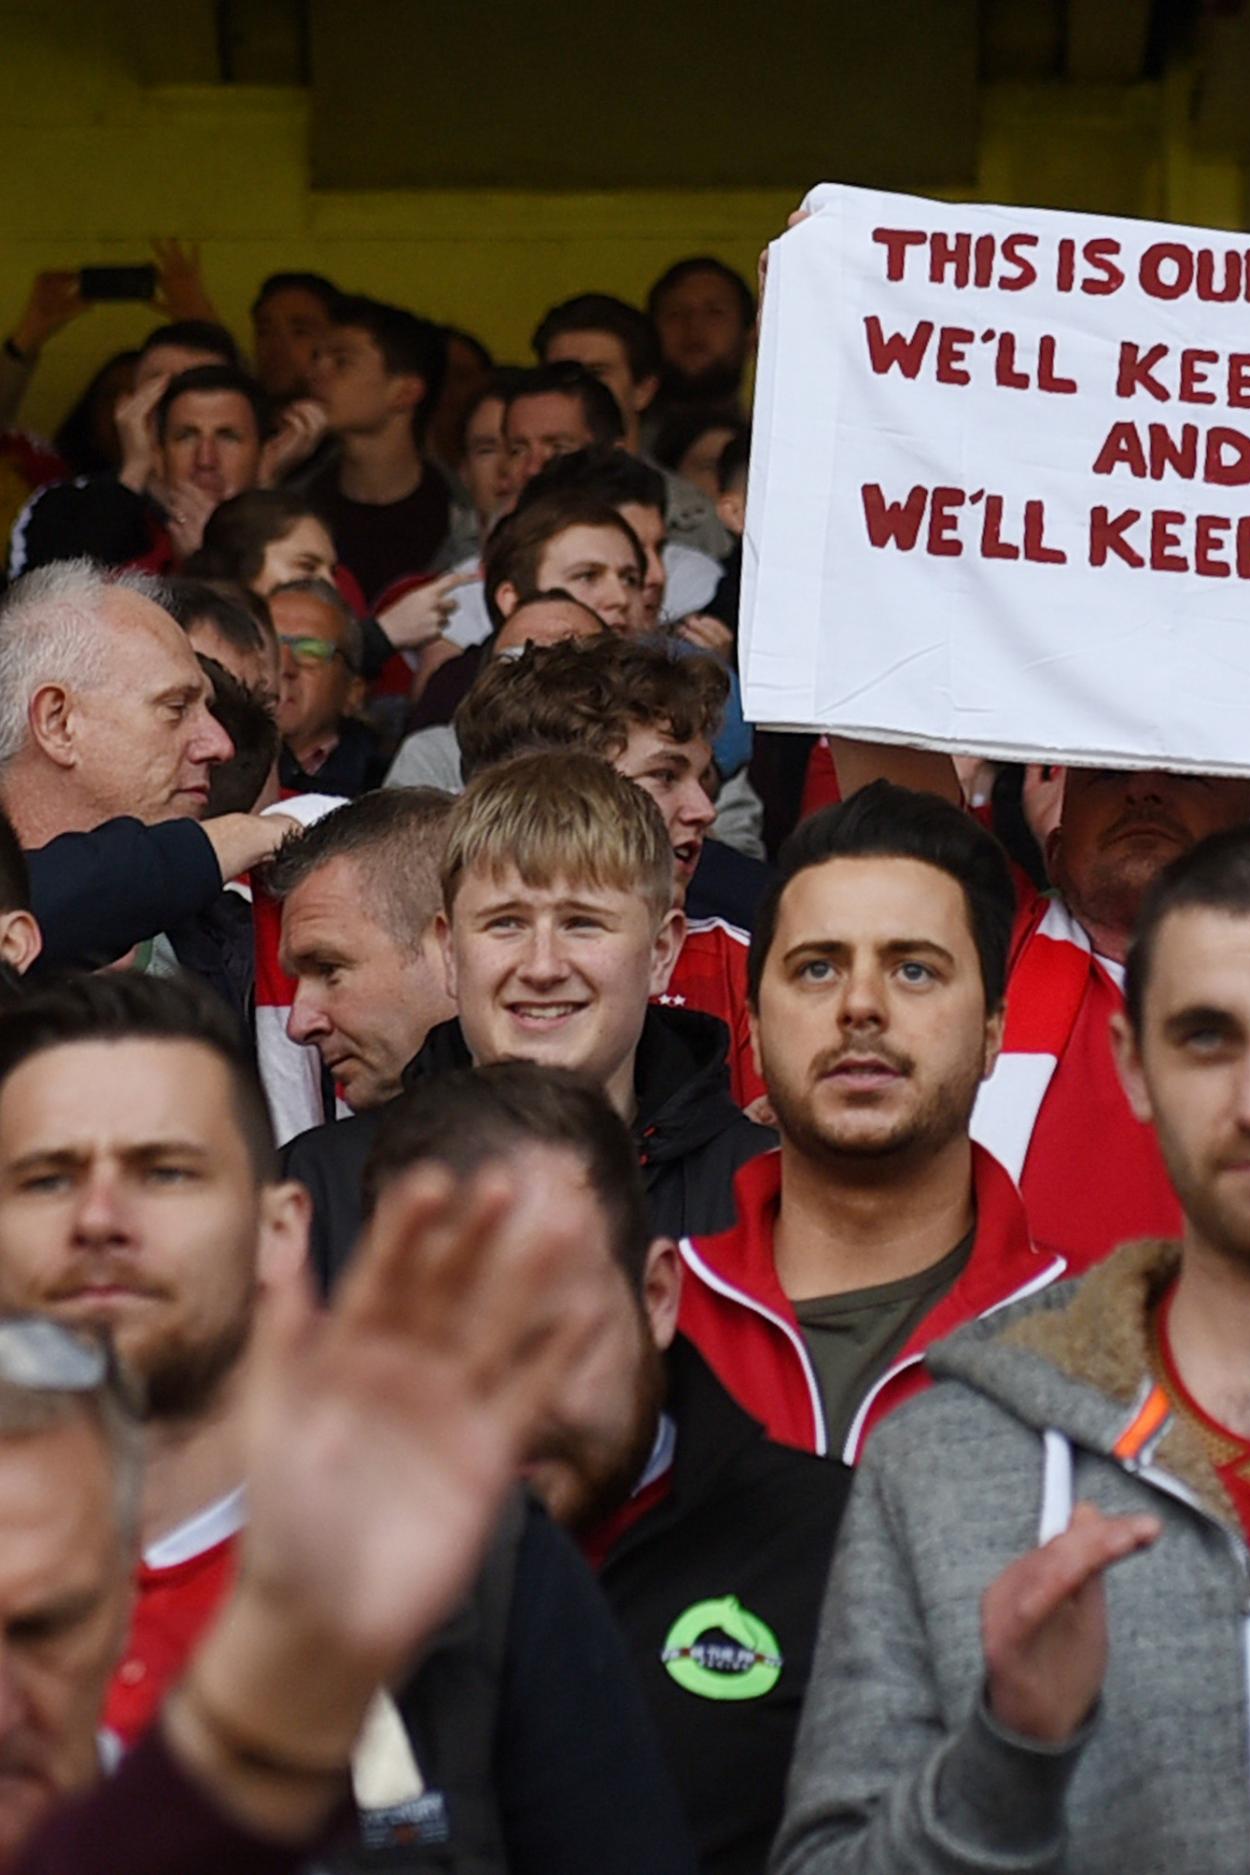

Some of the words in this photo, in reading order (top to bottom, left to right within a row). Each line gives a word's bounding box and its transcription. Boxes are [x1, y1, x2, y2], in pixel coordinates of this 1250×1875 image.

[873, 227, 1039, 292] THIS
[1056, 237, 1125, 296] IS
[865, 315, 1078, 395] WE'LL
[861, 483, 1068, 565] WE'LL
